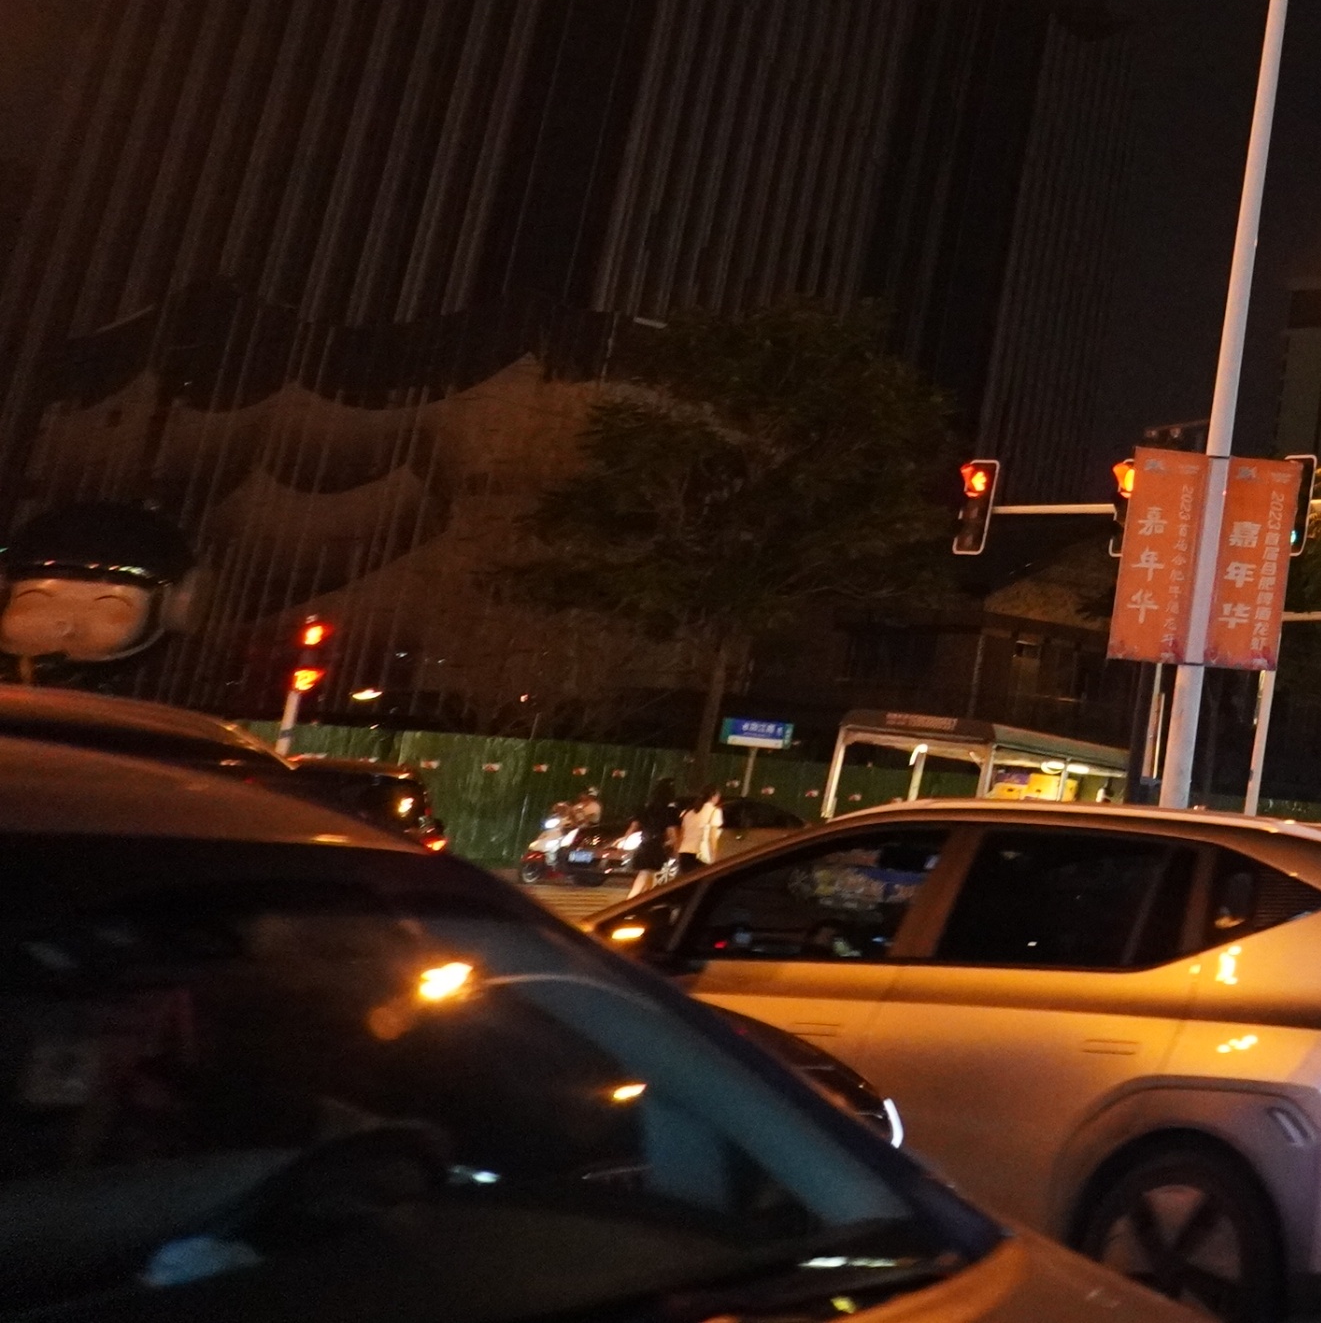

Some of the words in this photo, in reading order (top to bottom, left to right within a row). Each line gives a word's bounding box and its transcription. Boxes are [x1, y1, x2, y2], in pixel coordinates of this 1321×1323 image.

[1127, 506, 1168, 625] 嘉年华
[1218, 520, 1262, 628] 嘉年华
